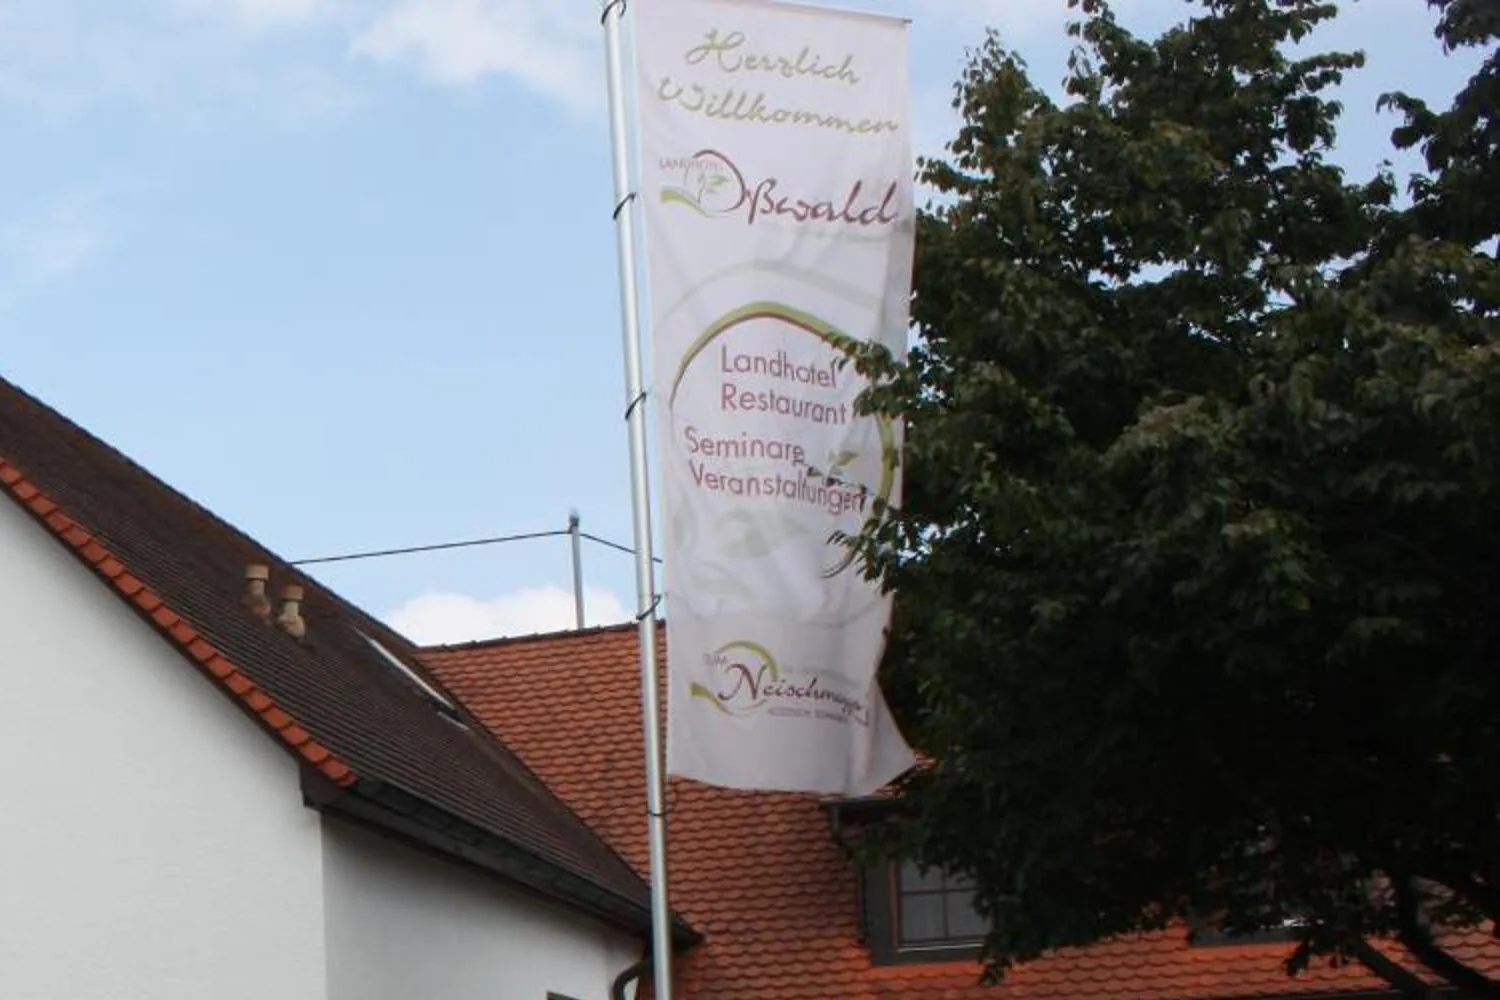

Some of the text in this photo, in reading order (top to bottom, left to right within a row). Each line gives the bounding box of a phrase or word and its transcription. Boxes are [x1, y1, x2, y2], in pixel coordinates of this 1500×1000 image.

[684, 28, 860, 84] Herzlich
[656, 76, 899, 134] Willkommen
[690, 149, 899, 225] Oßwald
[721, 344, 837, 388] Landhotel
[721, 382, 847, 425] Restaurant
[684, 425, 805, 463] Seminare
[688, 459, 868, 516] Veranstaltungen
